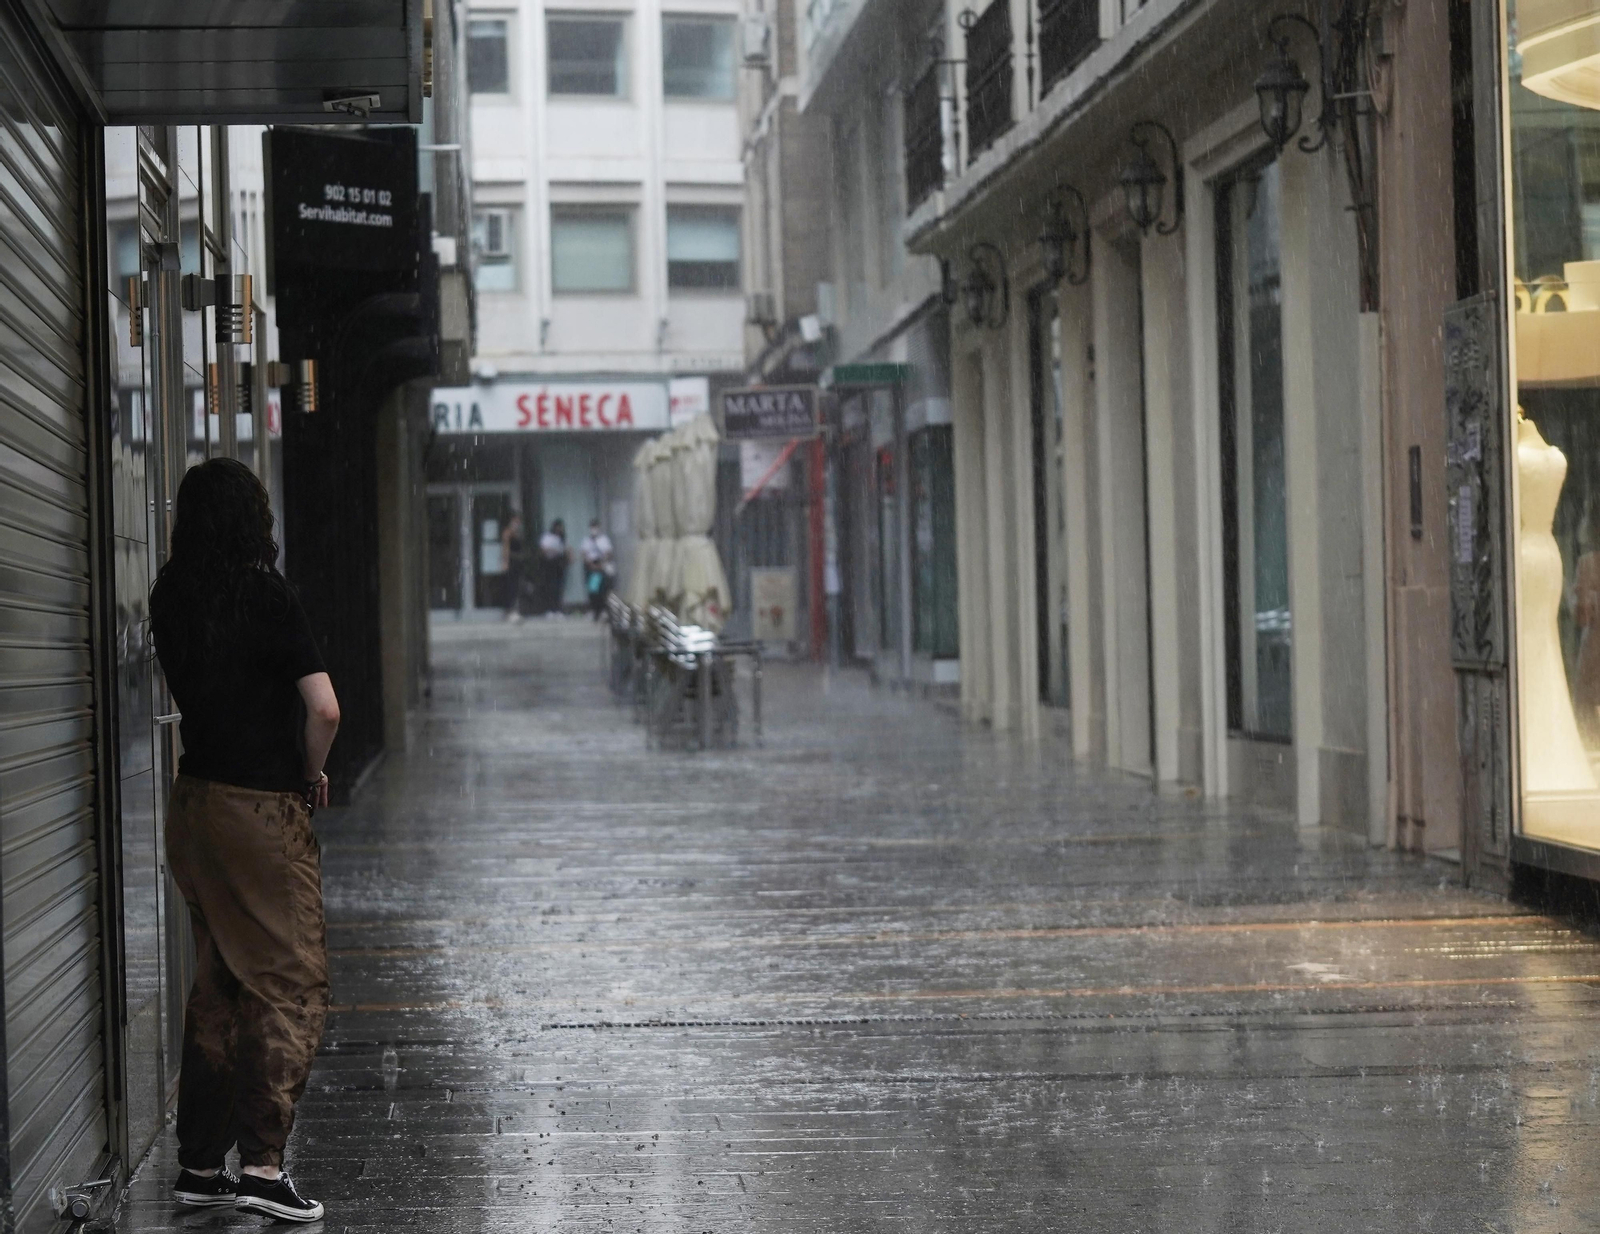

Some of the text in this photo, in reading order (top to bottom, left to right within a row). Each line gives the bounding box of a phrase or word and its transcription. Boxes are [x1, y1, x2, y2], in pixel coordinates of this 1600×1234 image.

[325, 184, 392, 206] 902 15 01 02
[299, 202, 392, 227] Servihabitat.com
[516, 387, 633, 427] SÉNECA
[725, 393, 805, 415] MARTA
